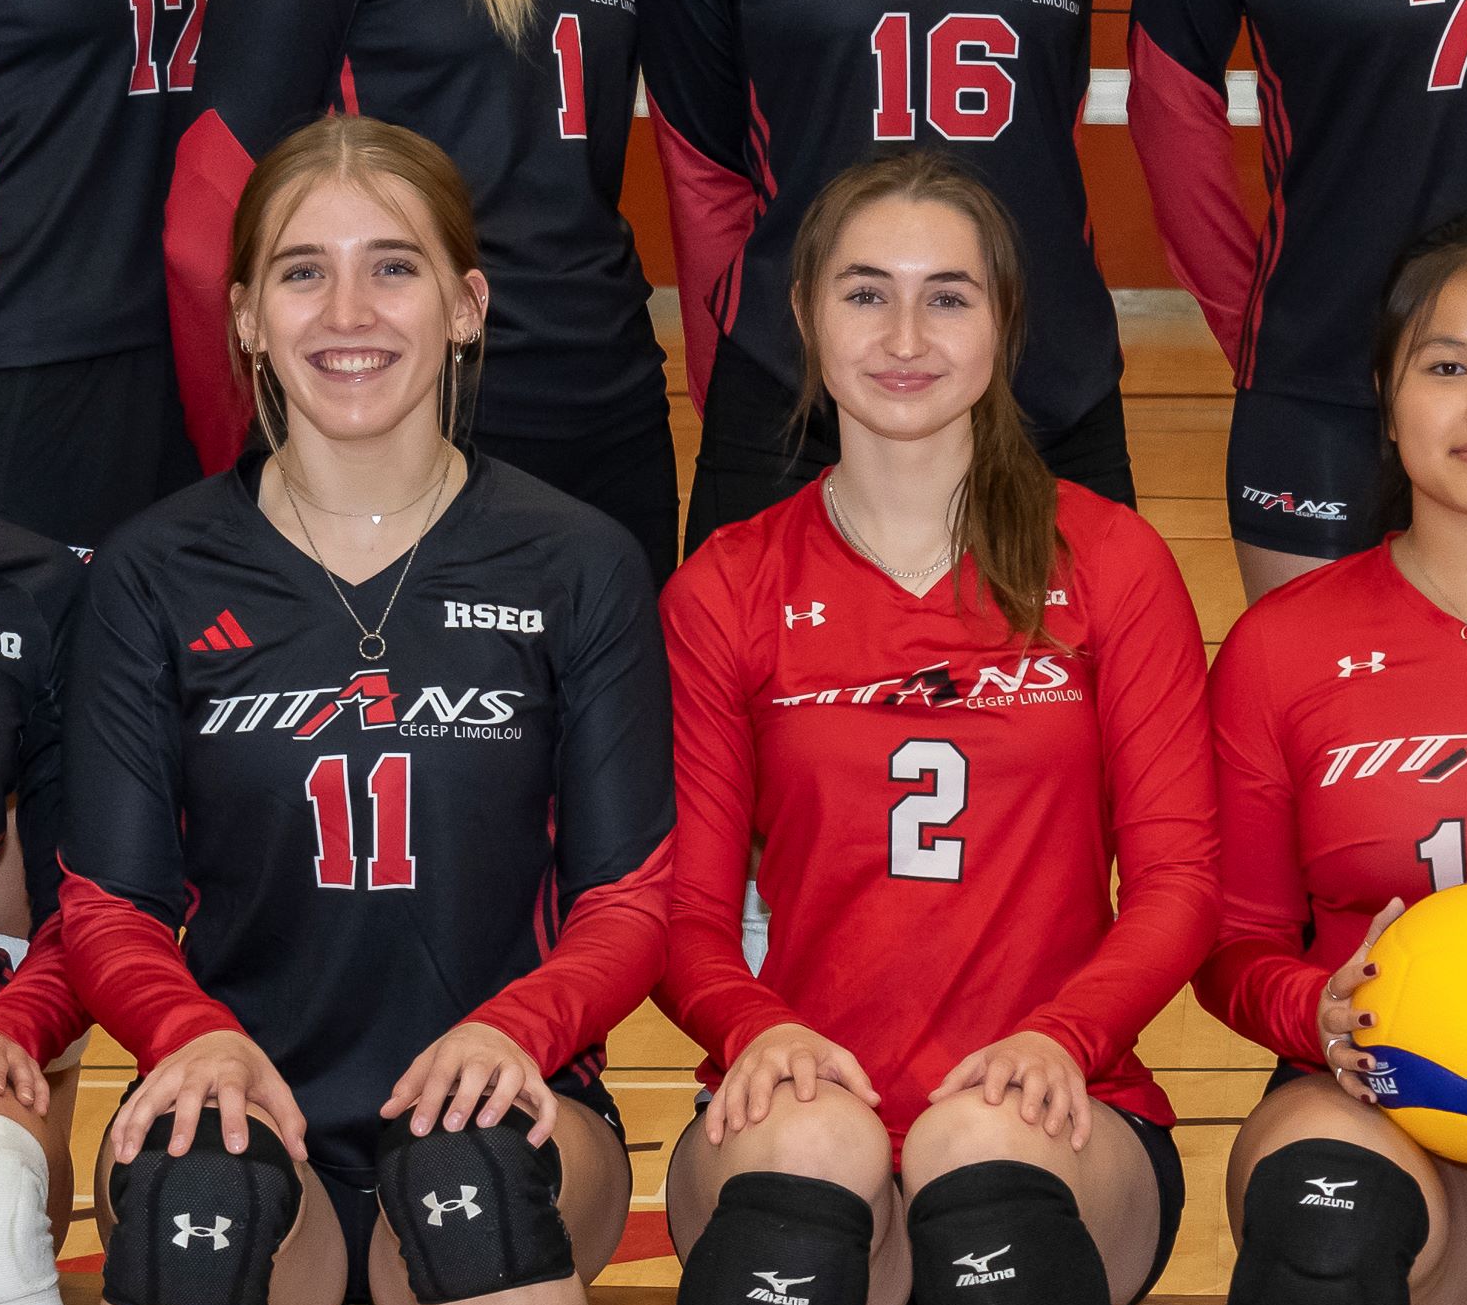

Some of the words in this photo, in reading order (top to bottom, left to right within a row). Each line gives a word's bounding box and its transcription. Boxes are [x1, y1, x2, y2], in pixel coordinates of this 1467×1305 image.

[552, 12, 589, 140] 1
[870, 11, 1021, 142] 16
[1241, 484, 1348, 516] TITANS
[443, 600, 545, 634] RSEQ
[199, 668, 526, 741] TITANS
[398, 718, 451, 739] CÉGEP
[453, 724, 523, 741] LIMOILOU
[1018, 688, 1084, 706] LIMOILOU
[304, 752, 416, 890] 11
[888, 738, 970, 884] 2
